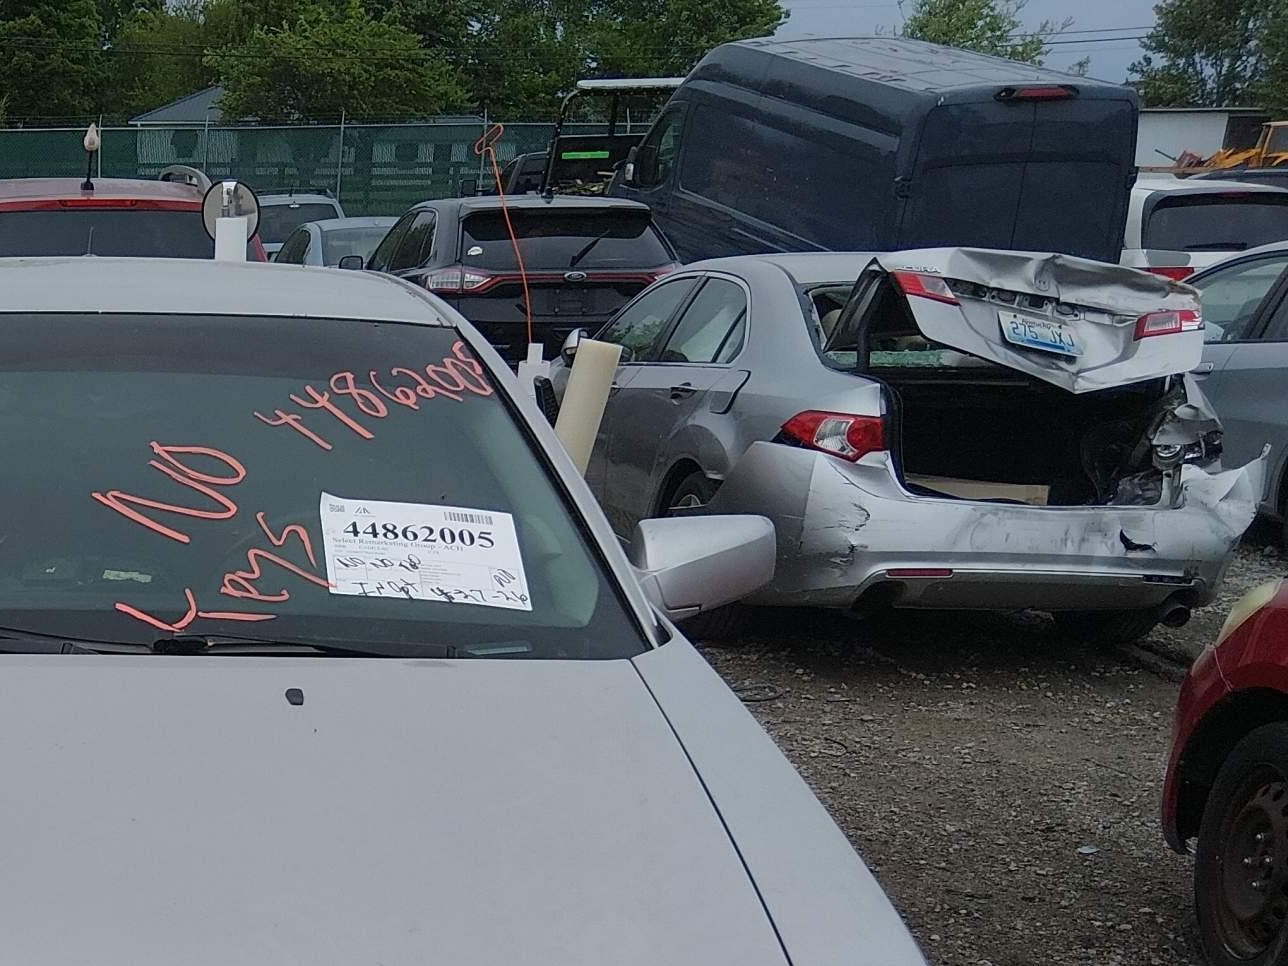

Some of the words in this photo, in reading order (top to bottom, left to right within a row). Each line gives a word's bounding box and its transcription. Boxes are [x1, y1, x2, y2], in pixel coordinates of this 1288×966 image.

[1010, 321, 1039, 339] 275
[91, 440, 247, 544] NO
[343, 521, 495, 548] 44862005
